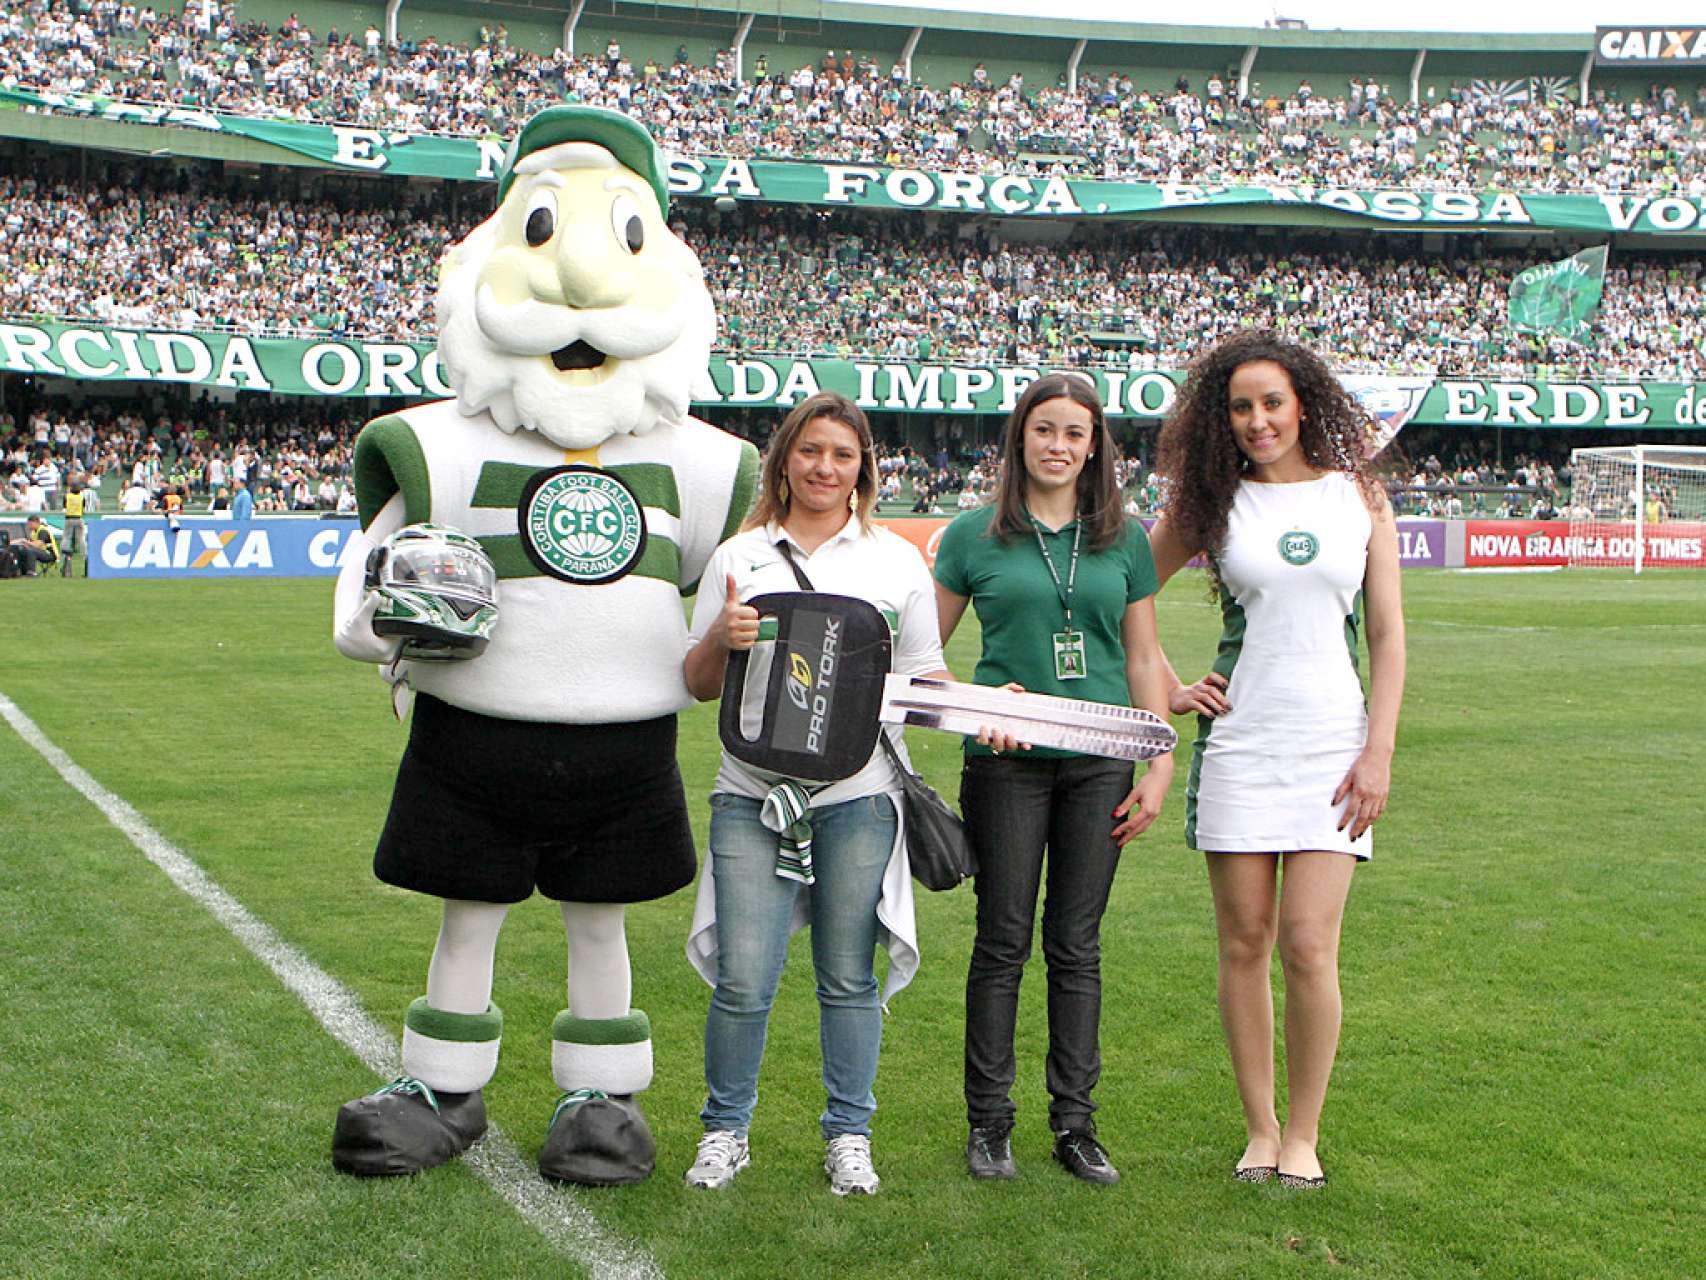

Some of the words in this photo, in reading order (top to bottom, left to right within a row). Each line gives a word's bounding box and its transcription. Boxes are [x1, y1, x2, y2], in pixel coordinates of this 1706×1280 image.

[553, 509, 619, 536] CFC
[558, 475, 598, 490] FOOT
[601, 479, 631, 511] BALL
[622, 514, 640, 551] CLUB
[101, 529, 273, 568] CAIXA
[1470, 535, 1522, 557] NOVA
[816, 616, 840, 690] TORK
[805, 694, 828, 754] PRO
